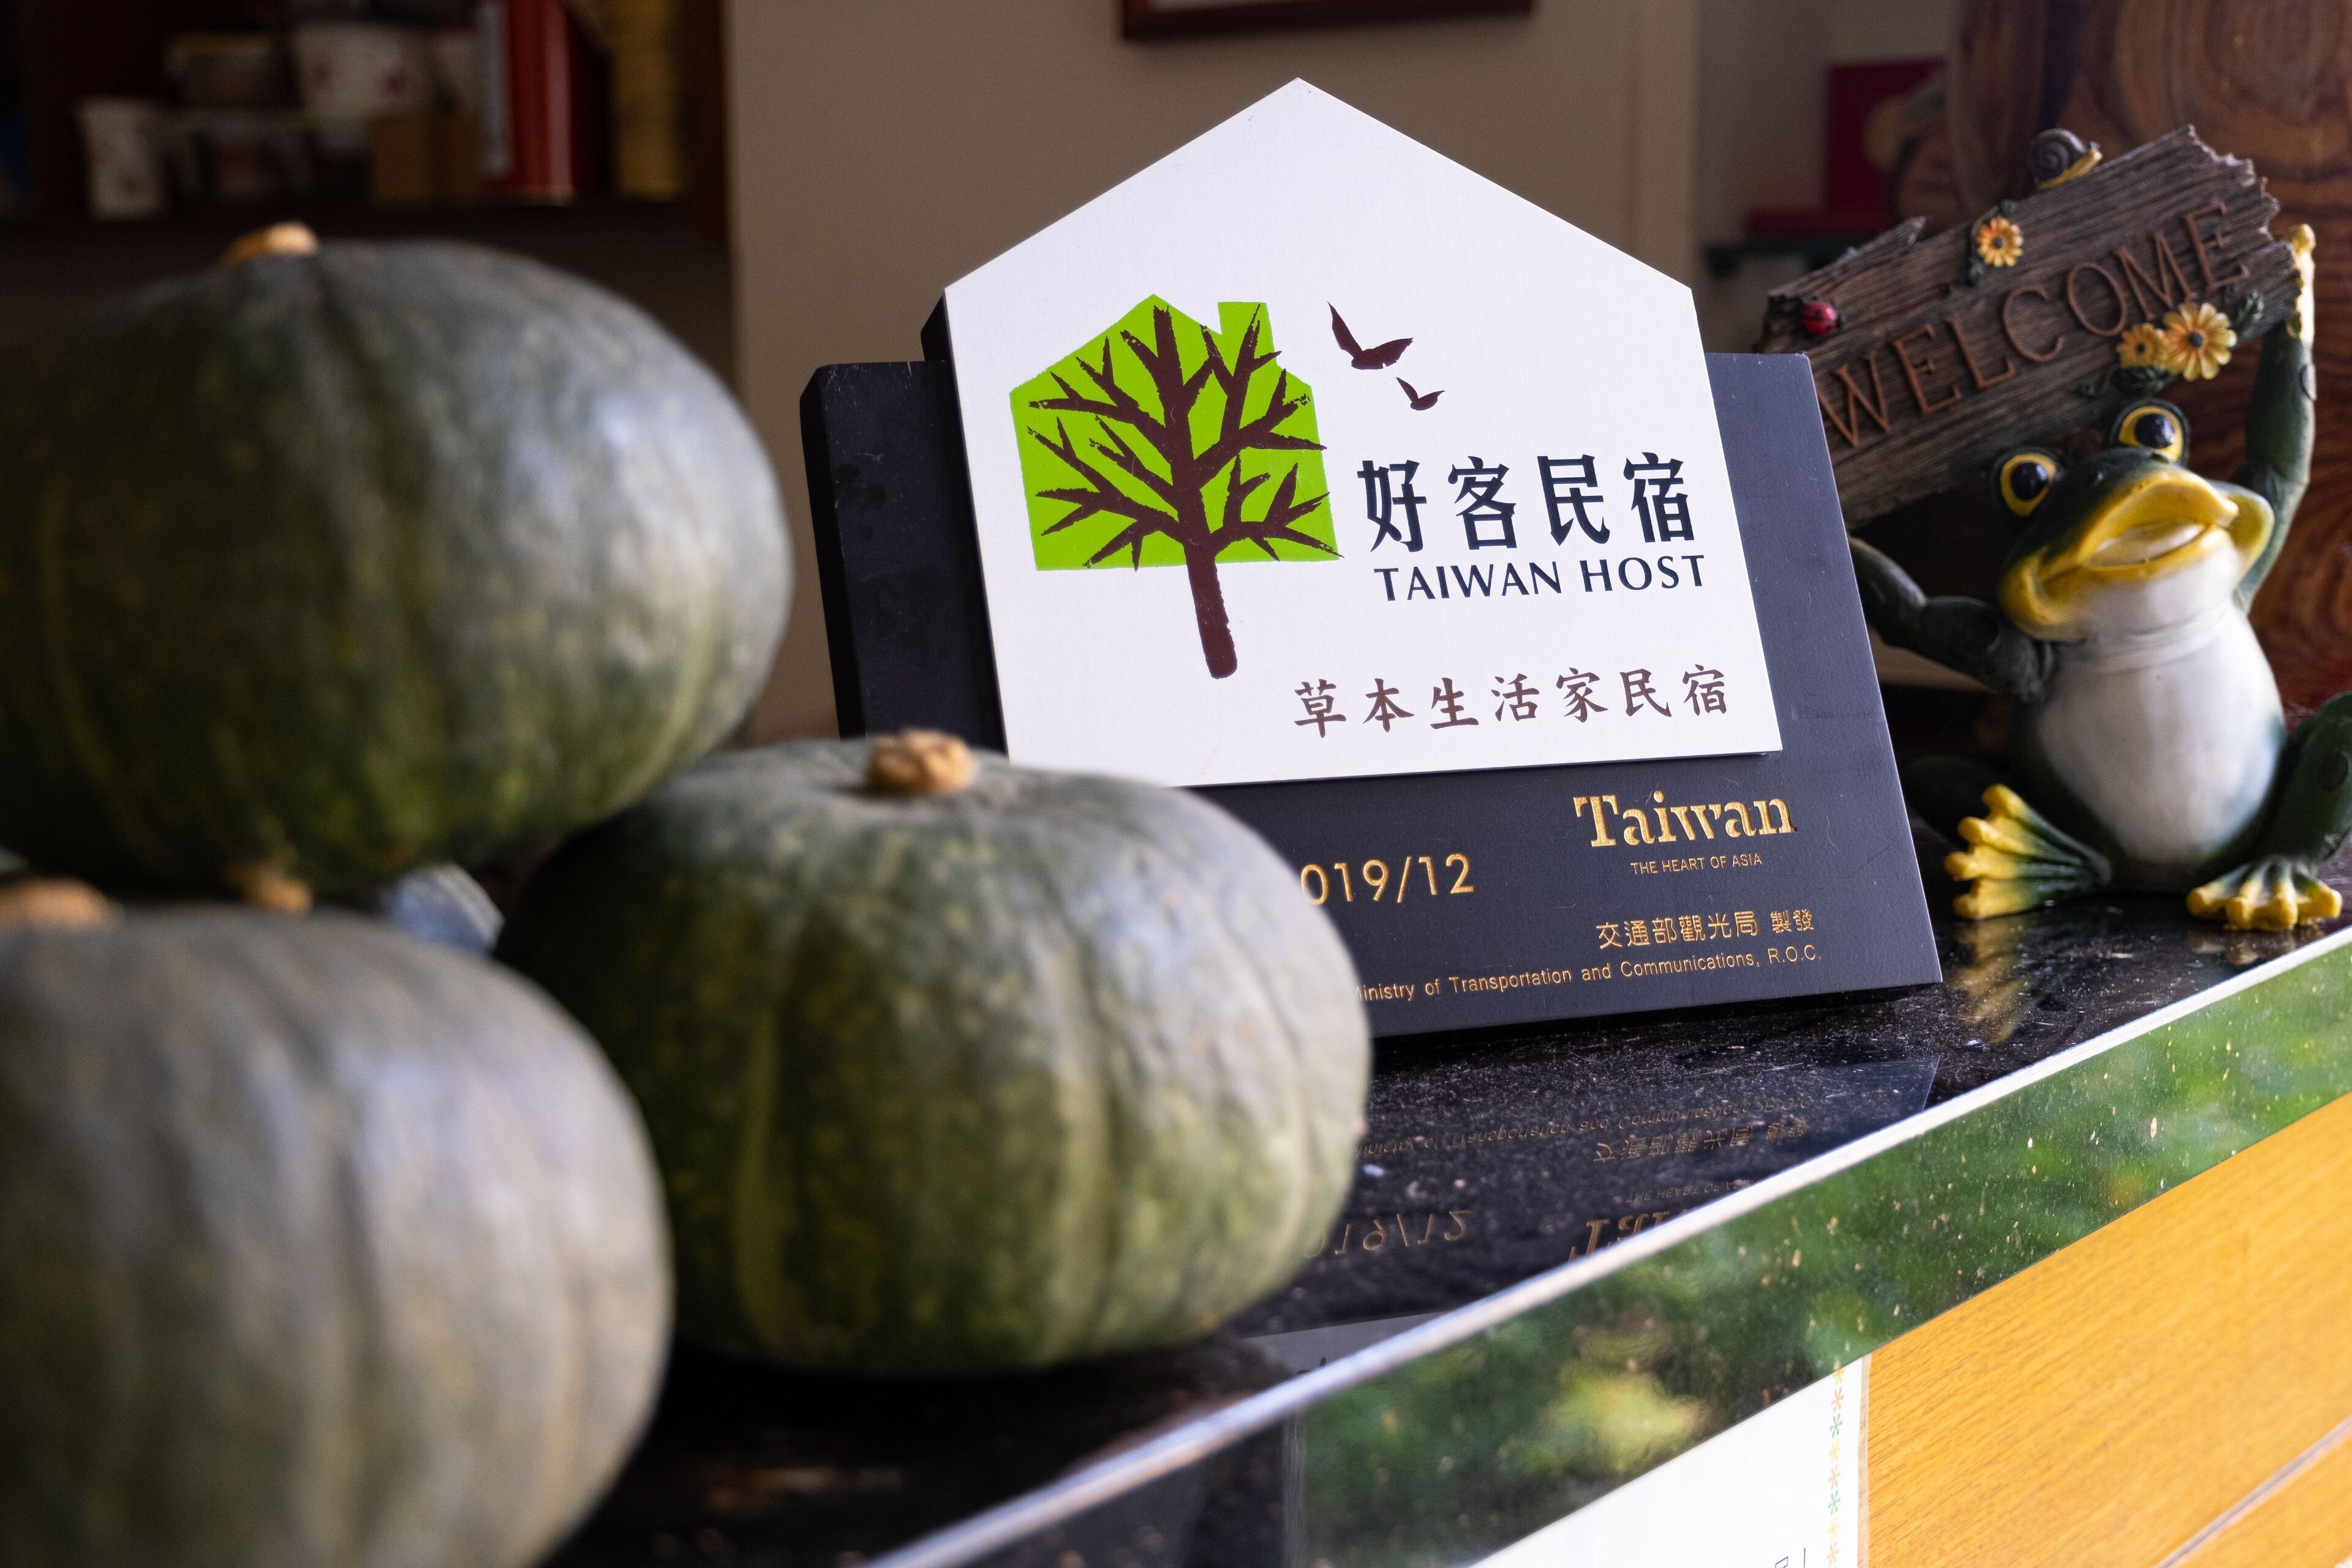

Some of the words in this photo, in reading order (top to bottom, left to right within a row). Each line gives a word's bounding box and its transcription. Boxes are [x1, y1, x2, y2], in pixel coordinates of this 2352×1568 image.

[1815, 202, 2250, 446] WELCOME
[1357, 451, 1696, 552] 好客民宿
[1374, 561, 1563, 601] TAIWAN
[1580, 554, 1705, 593] HOST
[1294, 663, 1728, 739] 草本生活家民宿
[1572, 790, 1797, 847] Taiwan
[1300, 853, 1475, 906] 019/12
[1630, 861, 1658, 875] THE
[1662, 857, 1705, 873] HEART
[1711, 856, 1727, 869] OF
[1732, 853, 1763, 867] ASIA
[1596, 910, 1760, 950] 交通部觀光局
[1770, 908, 1815, 935] 製發
[1425, 978, 1441, 996] of
[1449, 968, 1572, 993] Transportation
[1581, 963, 1612, 981] and
[1620, 952, 1761, 978] Communications,
[1767, 944, 1822, 965] R.O.C.
